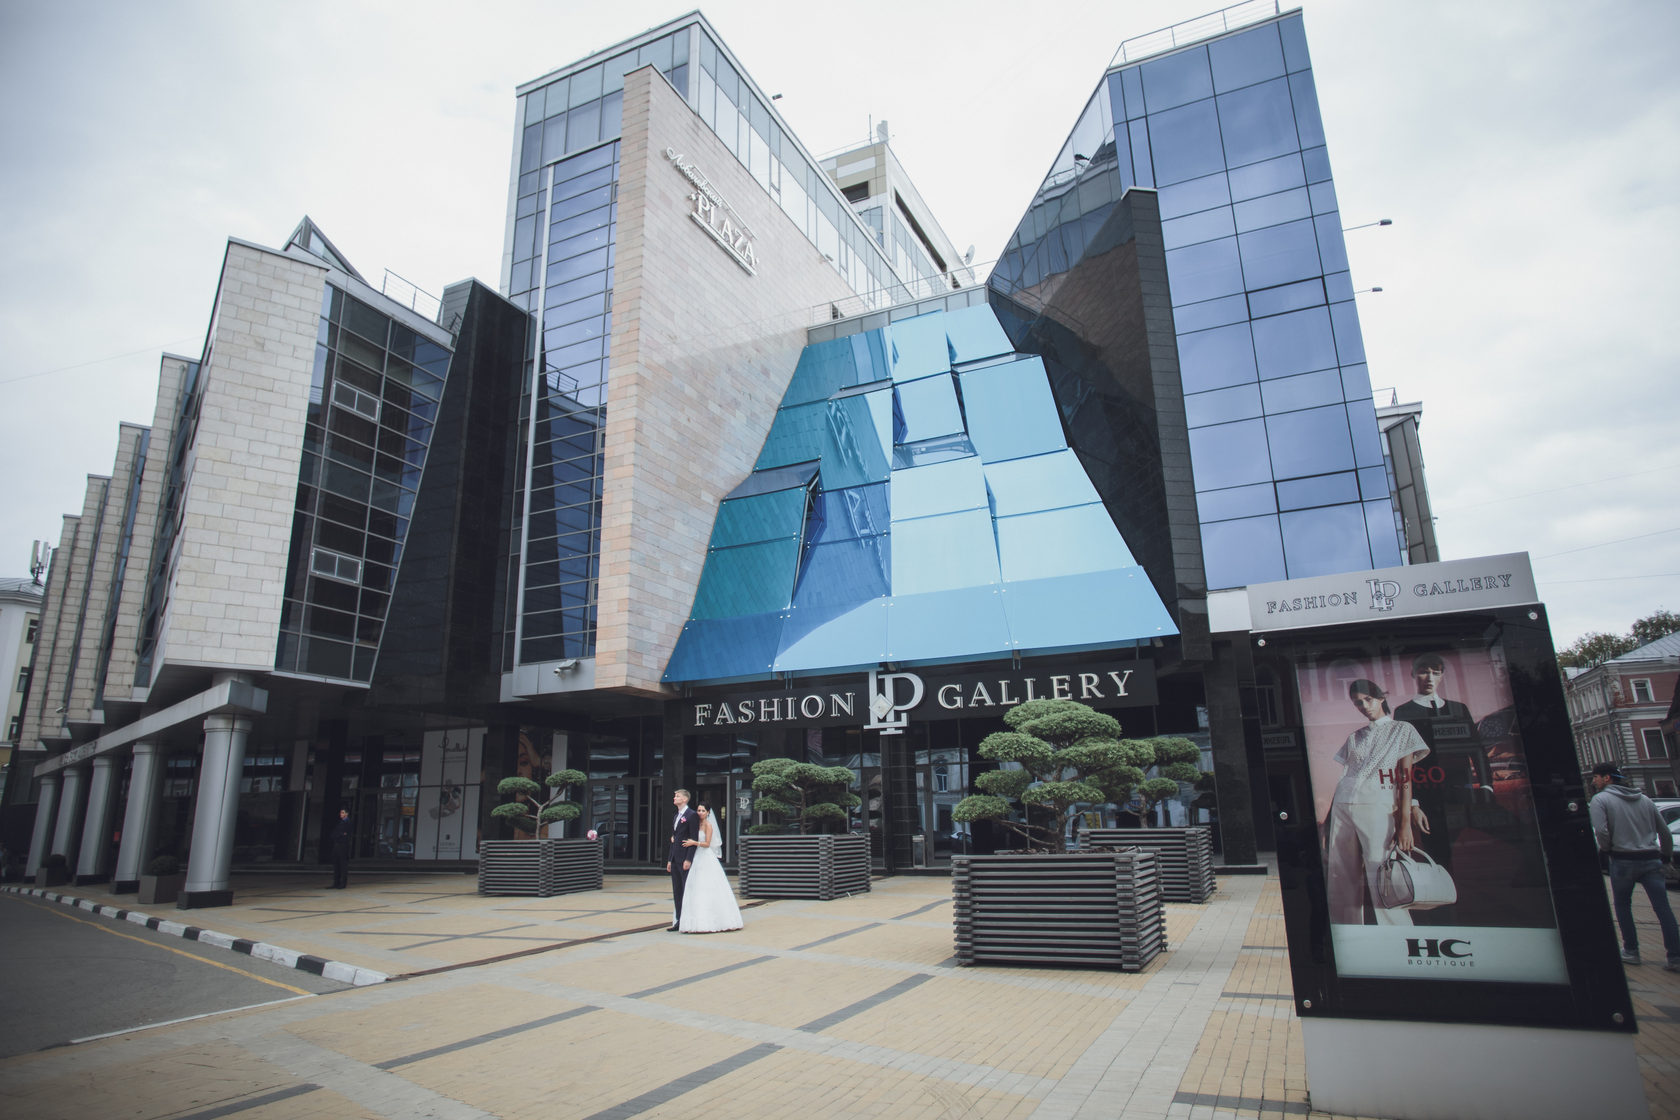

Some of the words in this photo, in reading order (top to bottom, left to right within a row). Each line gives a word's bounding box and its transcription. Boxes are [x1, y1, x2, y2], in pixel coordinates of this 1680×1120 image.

[697, 190, 758, 266] PLAZA
[1267, 592, 1358, 613] FASHION
[1414, 574, 1512, 596] GALLERY
[694, 692, 856, 727] FASHION
[937, 669, 1134, 709] GALLERY
[1378, 766, 1446, 784] HUGO
[1405, 938, 1473, 958] HC
[1407, 958, 1475, 967] BOUTIQUE
